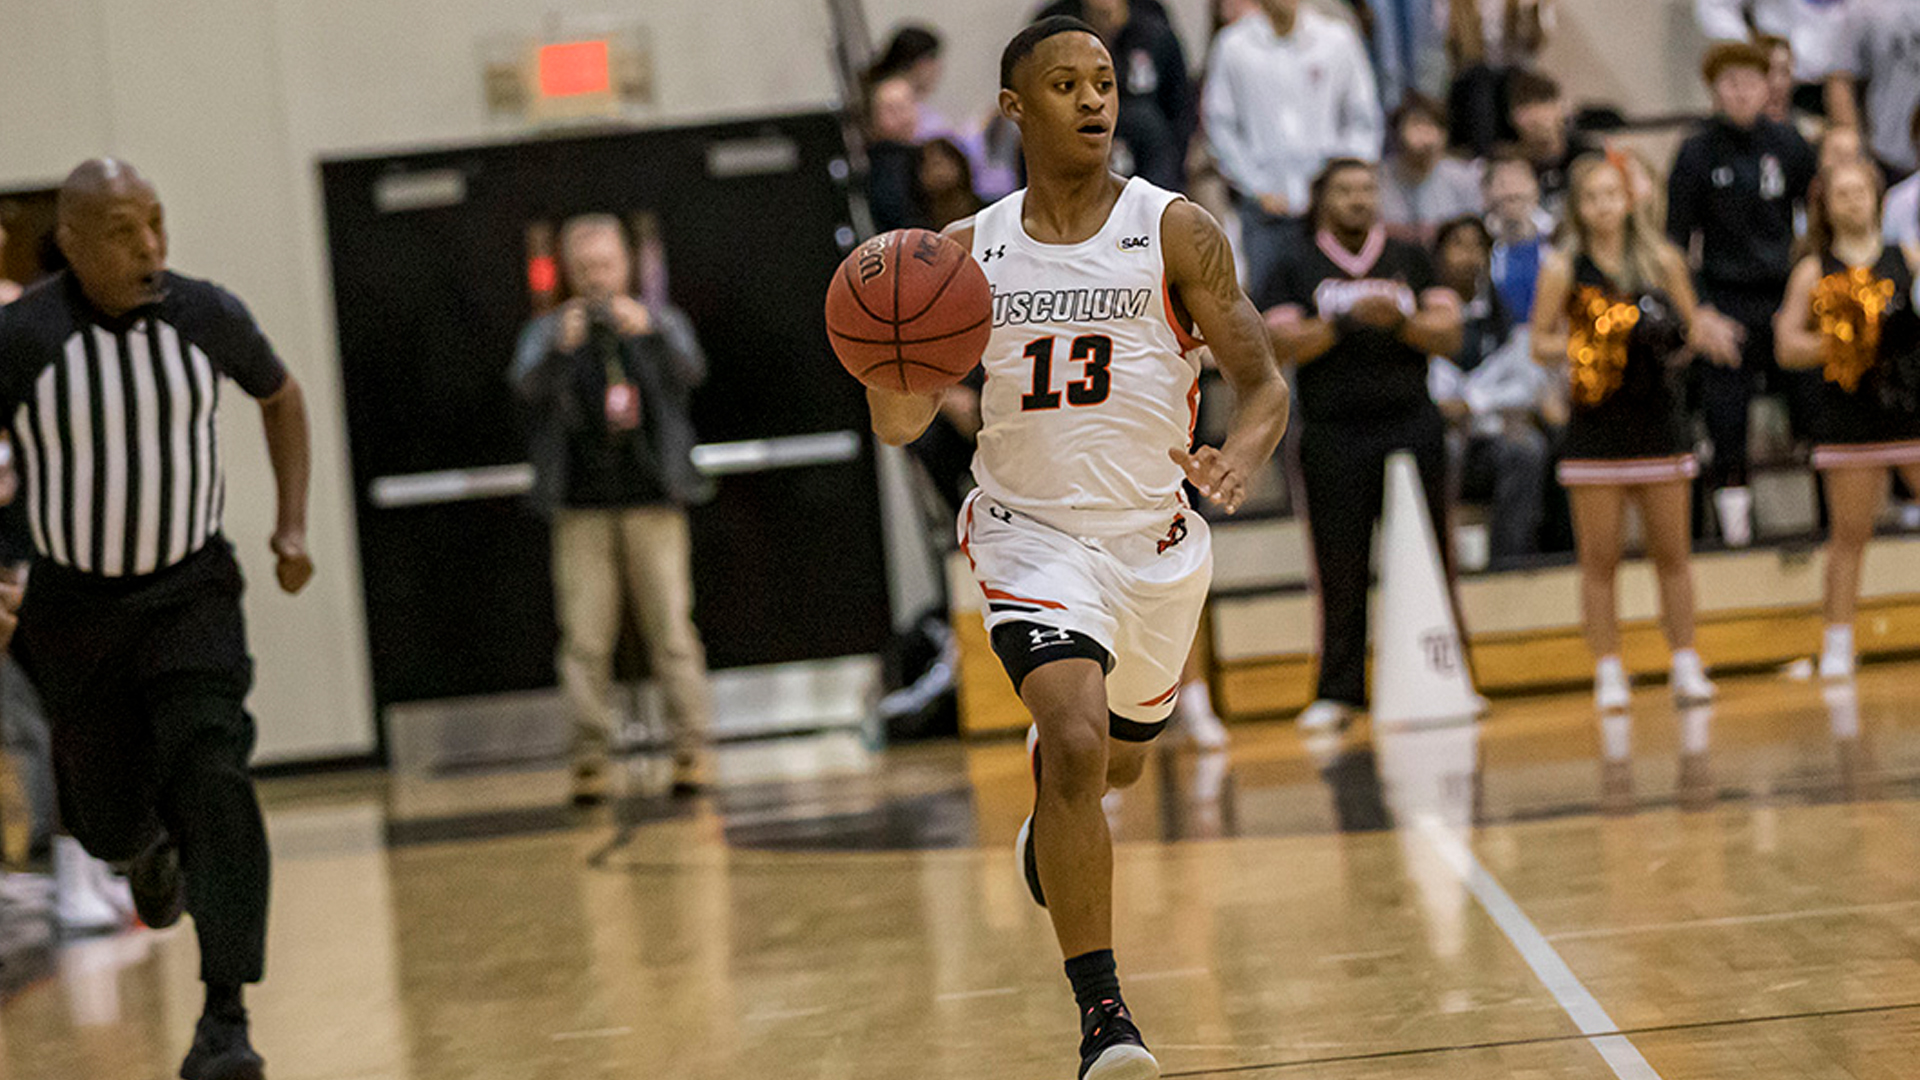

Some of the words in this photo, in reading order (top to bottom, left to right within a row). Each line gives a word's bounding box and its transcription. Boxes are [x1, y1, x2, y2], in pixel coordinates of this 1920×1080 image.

[1121, 236, 1149, 249] SAC
[990, 284, 1152, 328] USCULUM
[1021, 334, 1113, 412] 13
